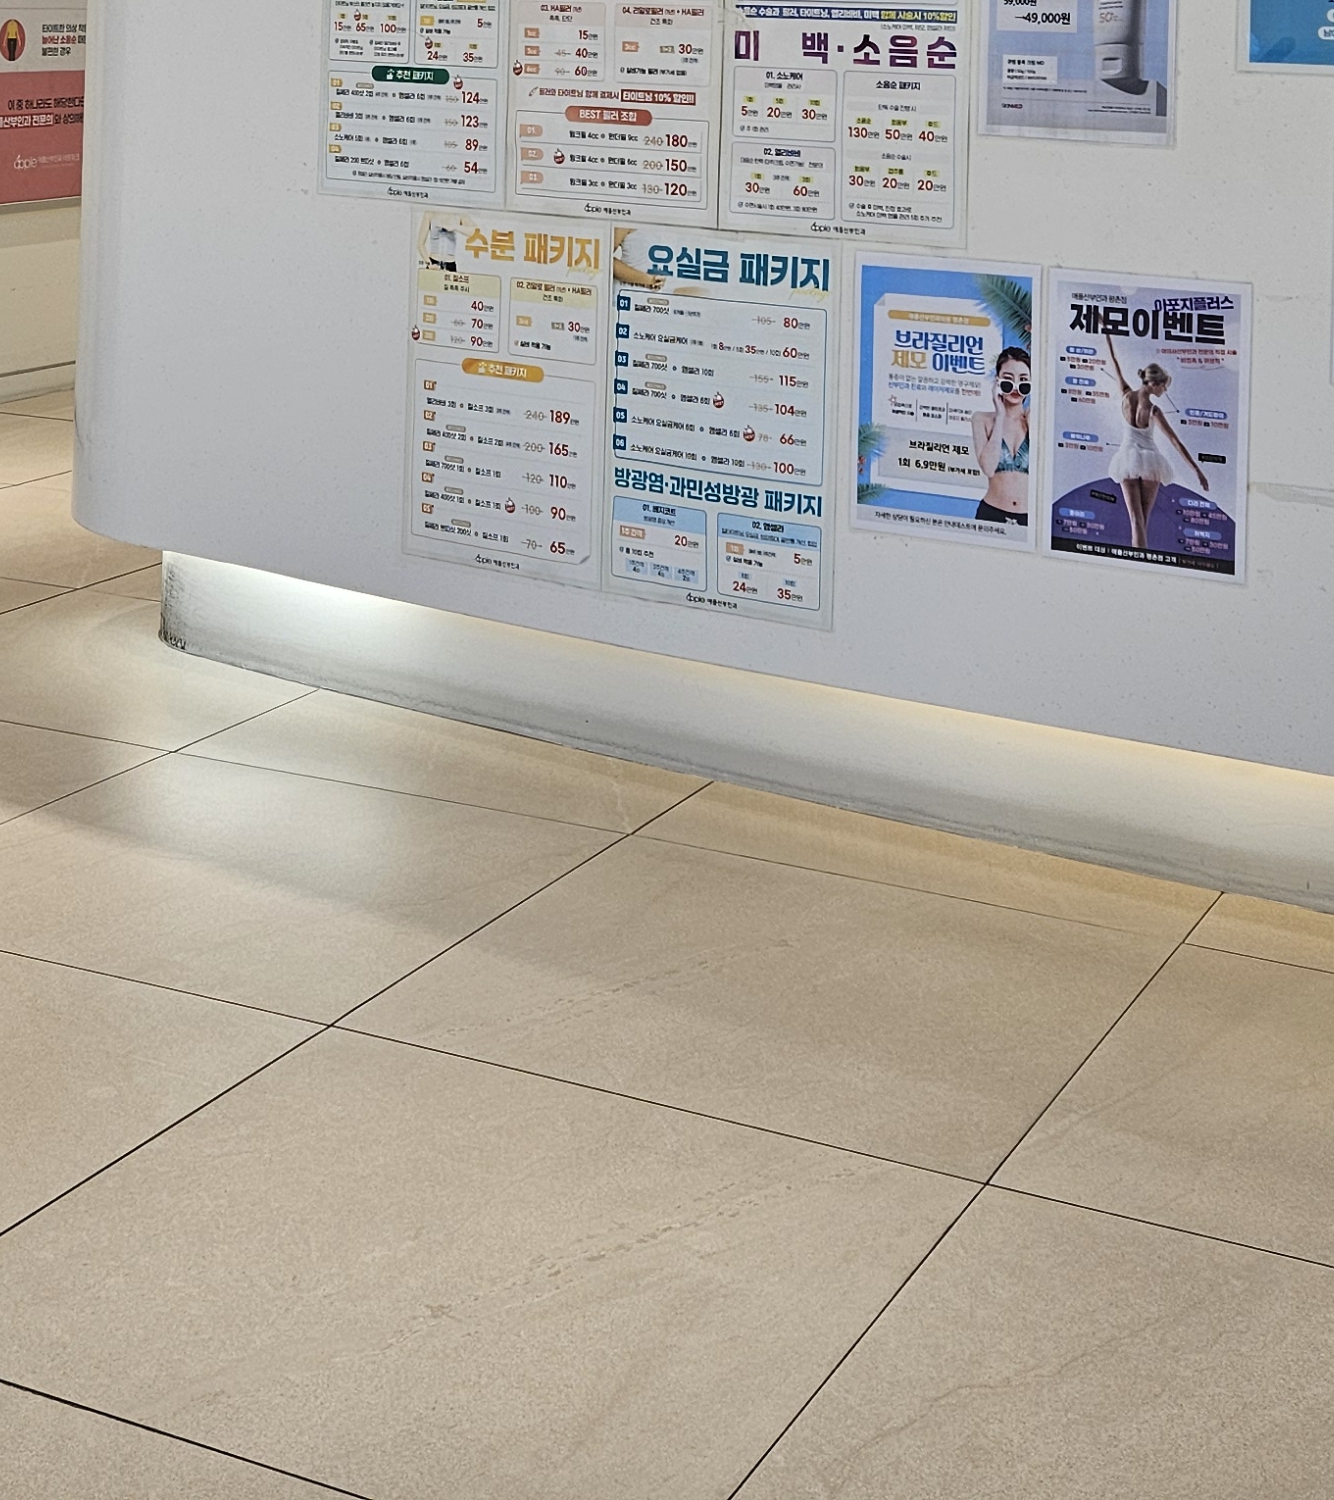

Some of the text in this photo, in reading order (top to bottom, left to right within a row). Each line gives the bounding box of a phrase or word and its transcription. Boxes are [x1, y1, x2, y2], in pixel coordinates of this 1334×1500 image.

[465, 228, 600, 270] 수분 패키지
[647, 244, 830, 292] 요실금 패키지
[1154, 295, 1235, 312] 아포지플러스
[1069, 302, 1226, 346] 제모이벤트
[894, 329, 984, 354] 브라질리언
[891, 349, 986, 375] 제모 이벤트
[909, 440, 951, 455] 브라질리언
[764, 489, 822, 518] 패키지
